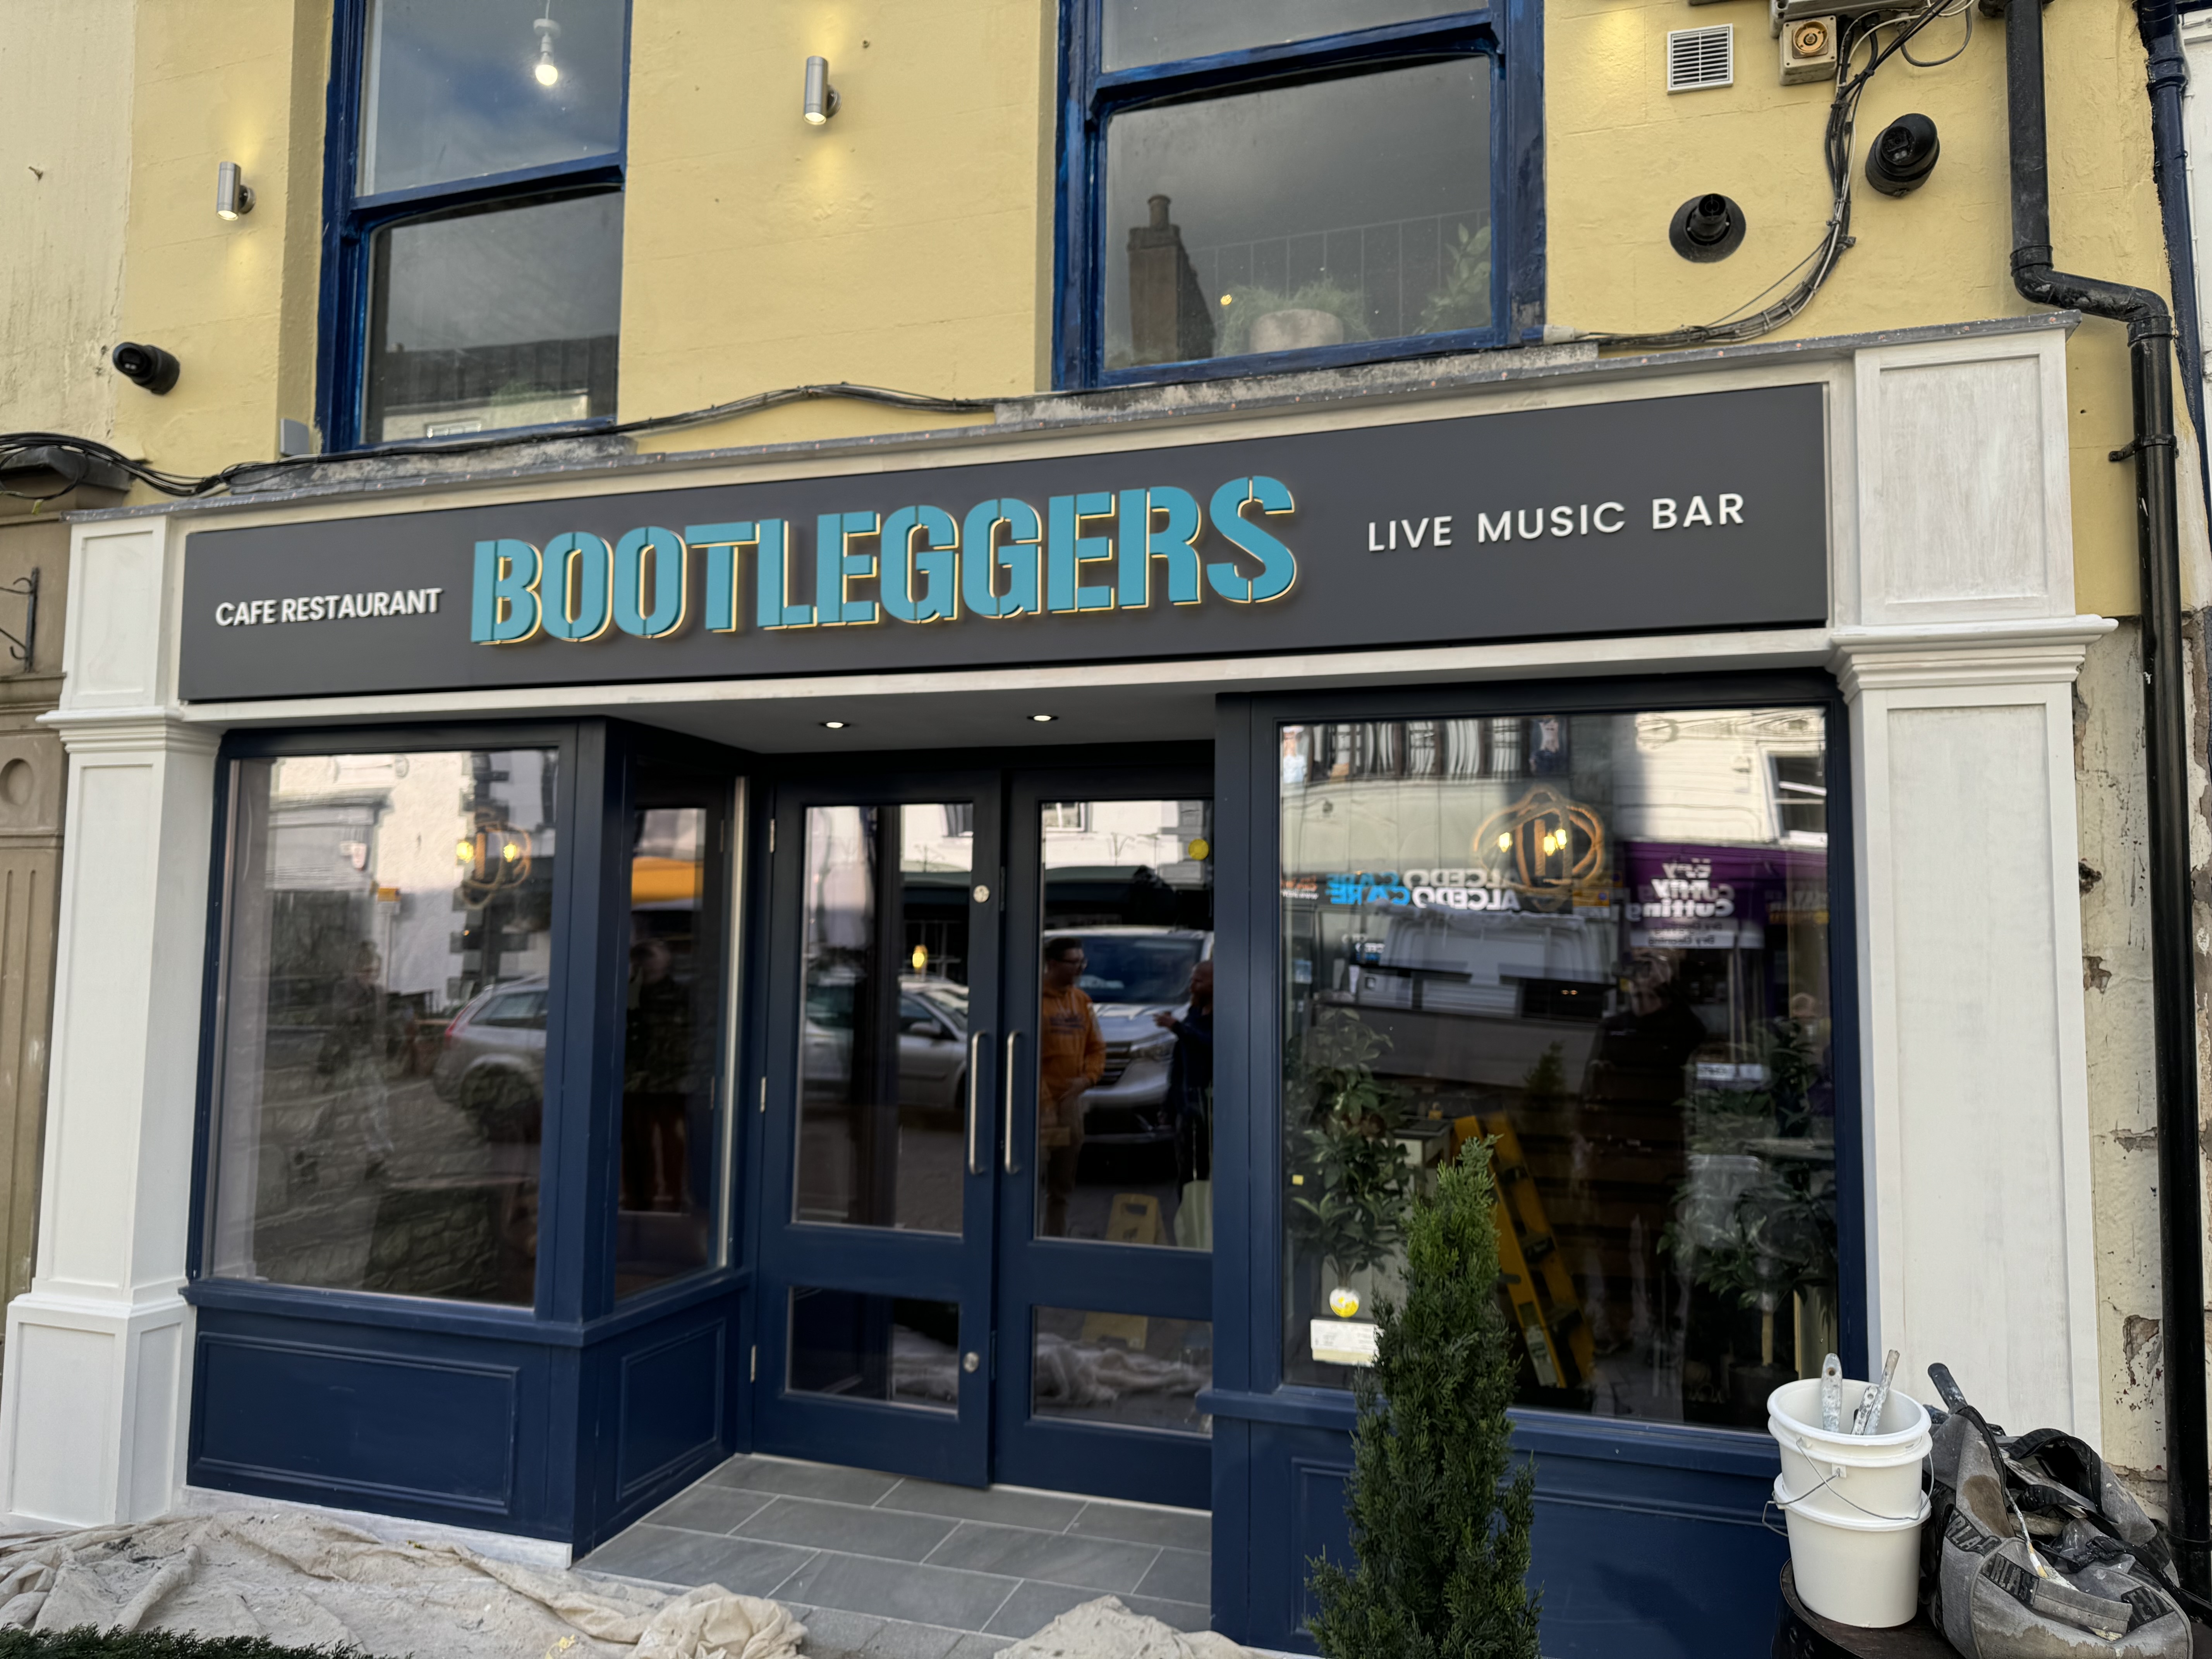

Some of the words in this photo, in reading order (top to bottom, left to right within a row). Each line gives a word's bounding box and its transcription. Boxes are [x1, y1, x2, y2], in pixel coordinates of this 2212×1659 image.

[1369, 516, 1452, 552] LIVE
[1478, 502, 1625, 543] MUSIC
[1652, 493, 1744, 530] BAR
[470, 475, 1298, 646] BOOTLEGGERS
[216, 599, 277, 626] CAFE
[281, 587, 442, 623] RESTAURANT
